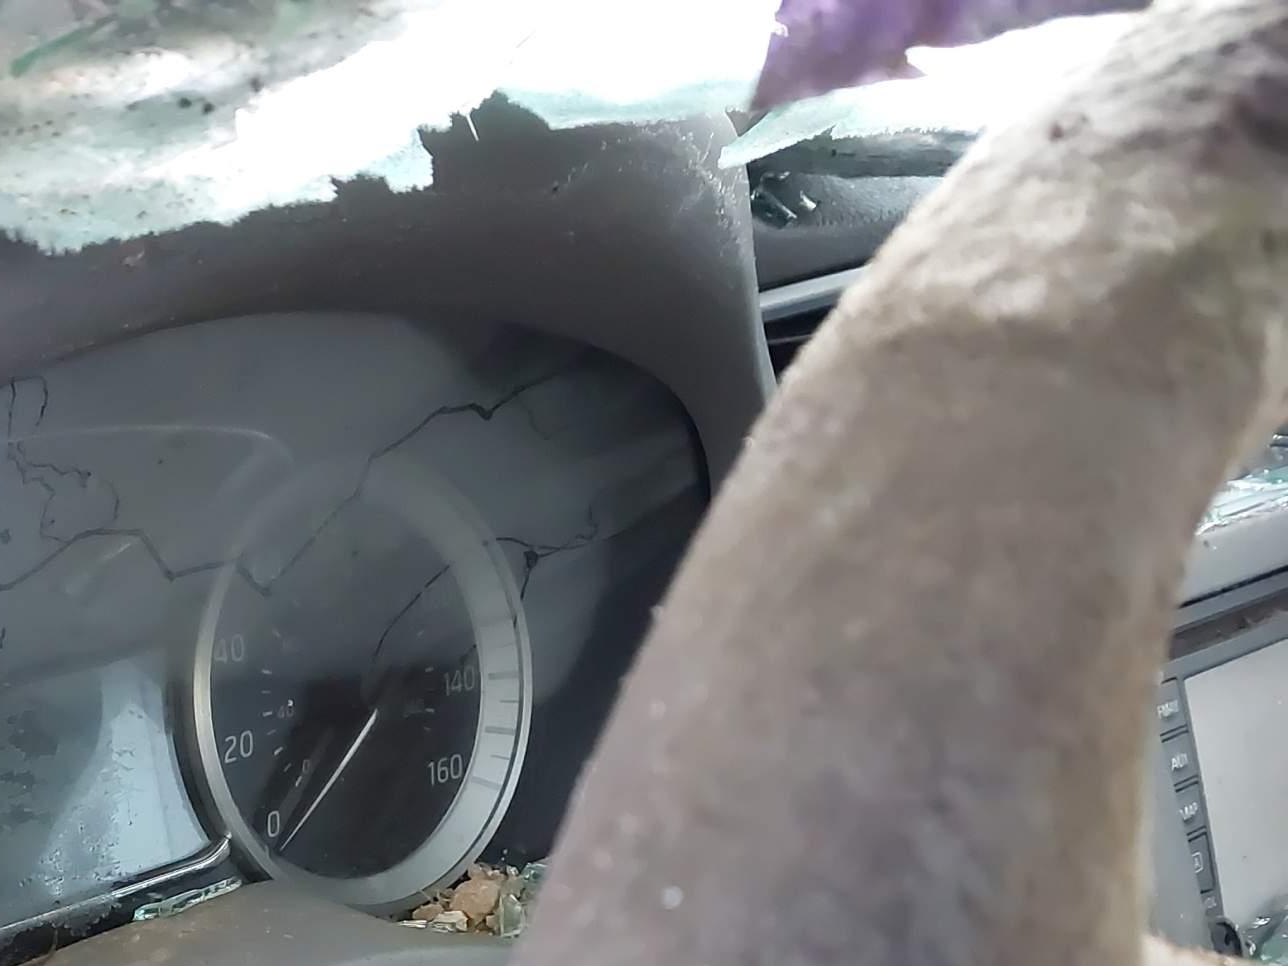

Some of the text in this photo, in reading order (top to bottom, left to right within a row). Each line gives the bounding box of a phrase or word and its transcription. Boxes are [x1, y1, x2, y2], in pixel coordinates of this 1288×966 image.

[444, 665, 475, 696] 140
[224, 730, 253, 764] 20
[426, 753, 464, 788] 160
[267, 810, 280, 838] 0
